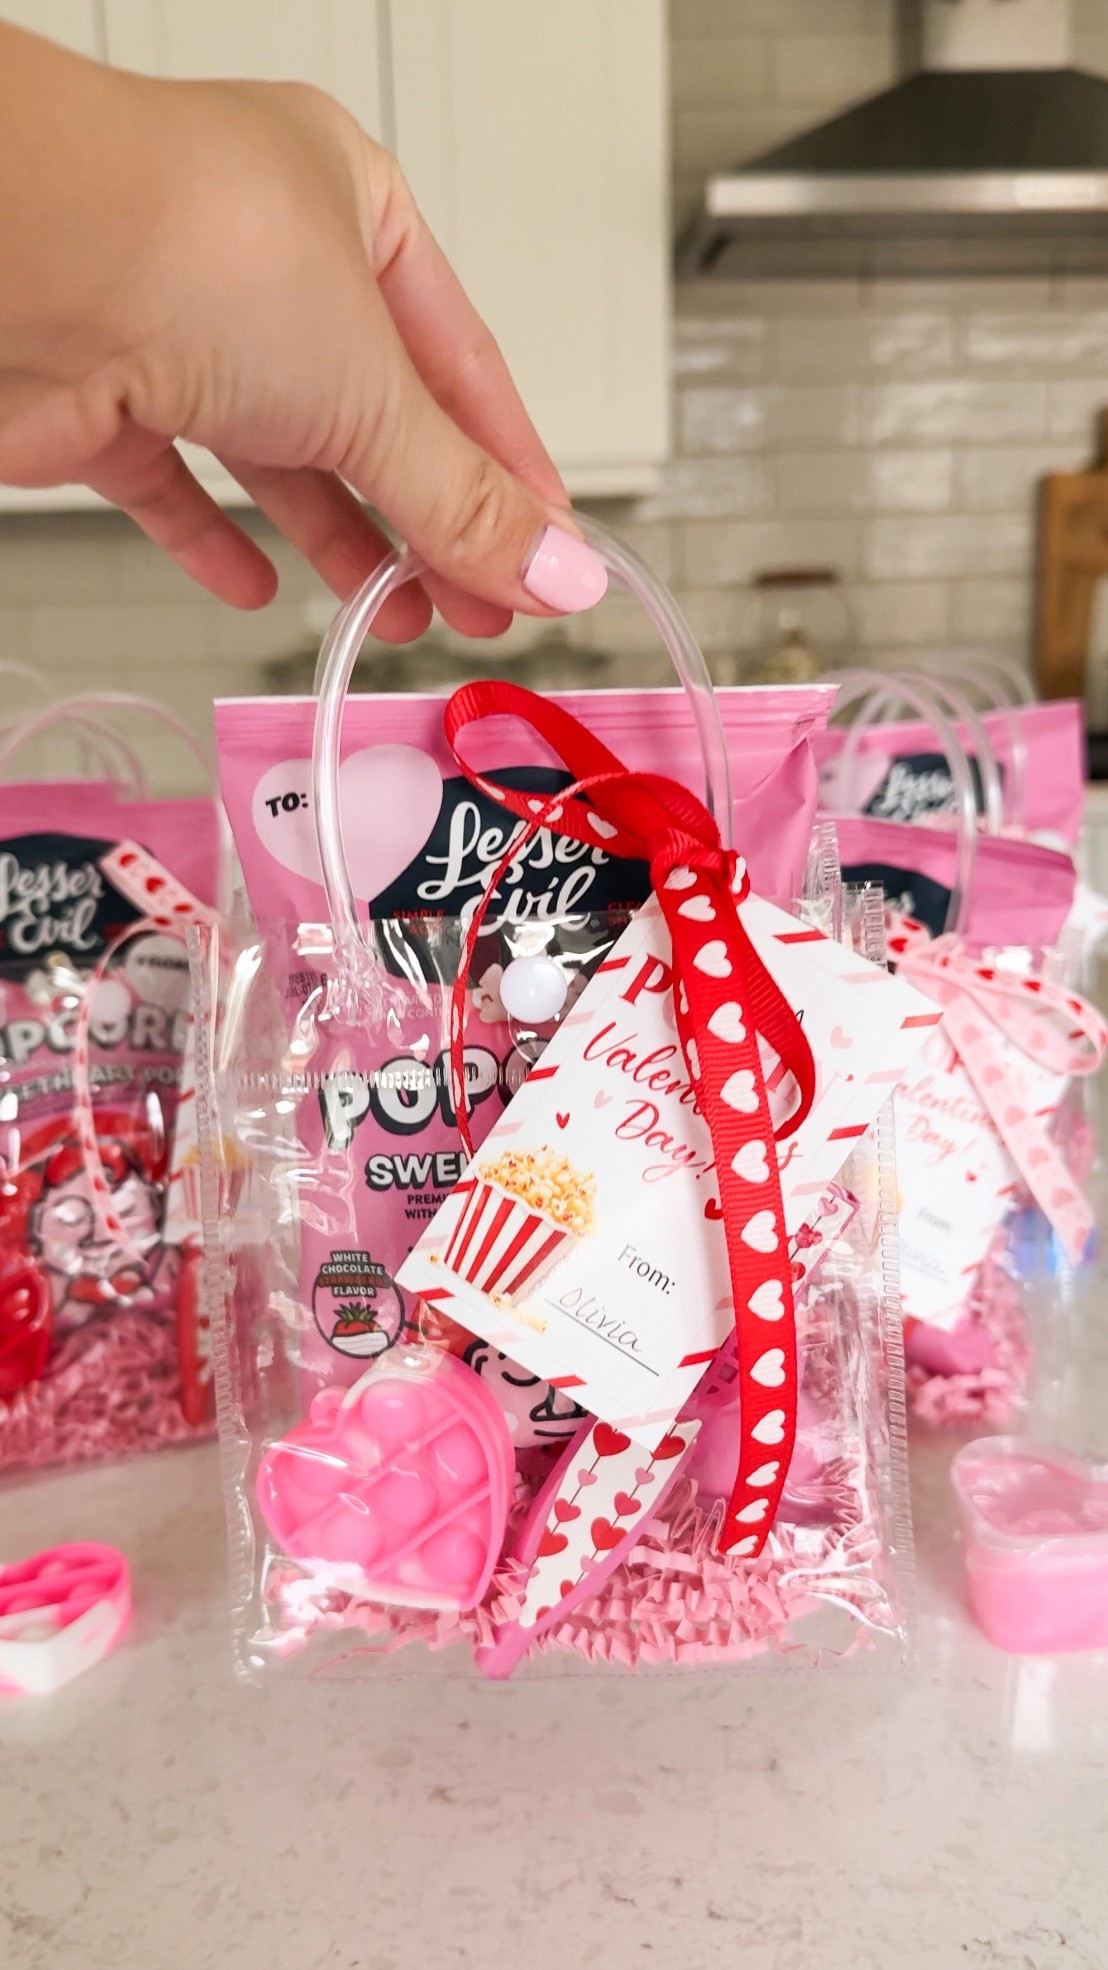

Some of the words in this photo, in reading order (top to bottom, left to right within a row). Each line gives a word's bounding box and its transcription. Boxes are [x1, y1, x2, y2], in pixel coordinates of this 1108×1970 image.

[265, 792, 309, 818] TO:
[332, 1253, 369, 1263] WHITE
[321, 1264, 384, 1275] CHOCOLATE
[617, 1244, 676, 1295] From:
[334, 1286, 375, 1296] FLAVOR
[558, 1287, 643, 1353] Olivia
